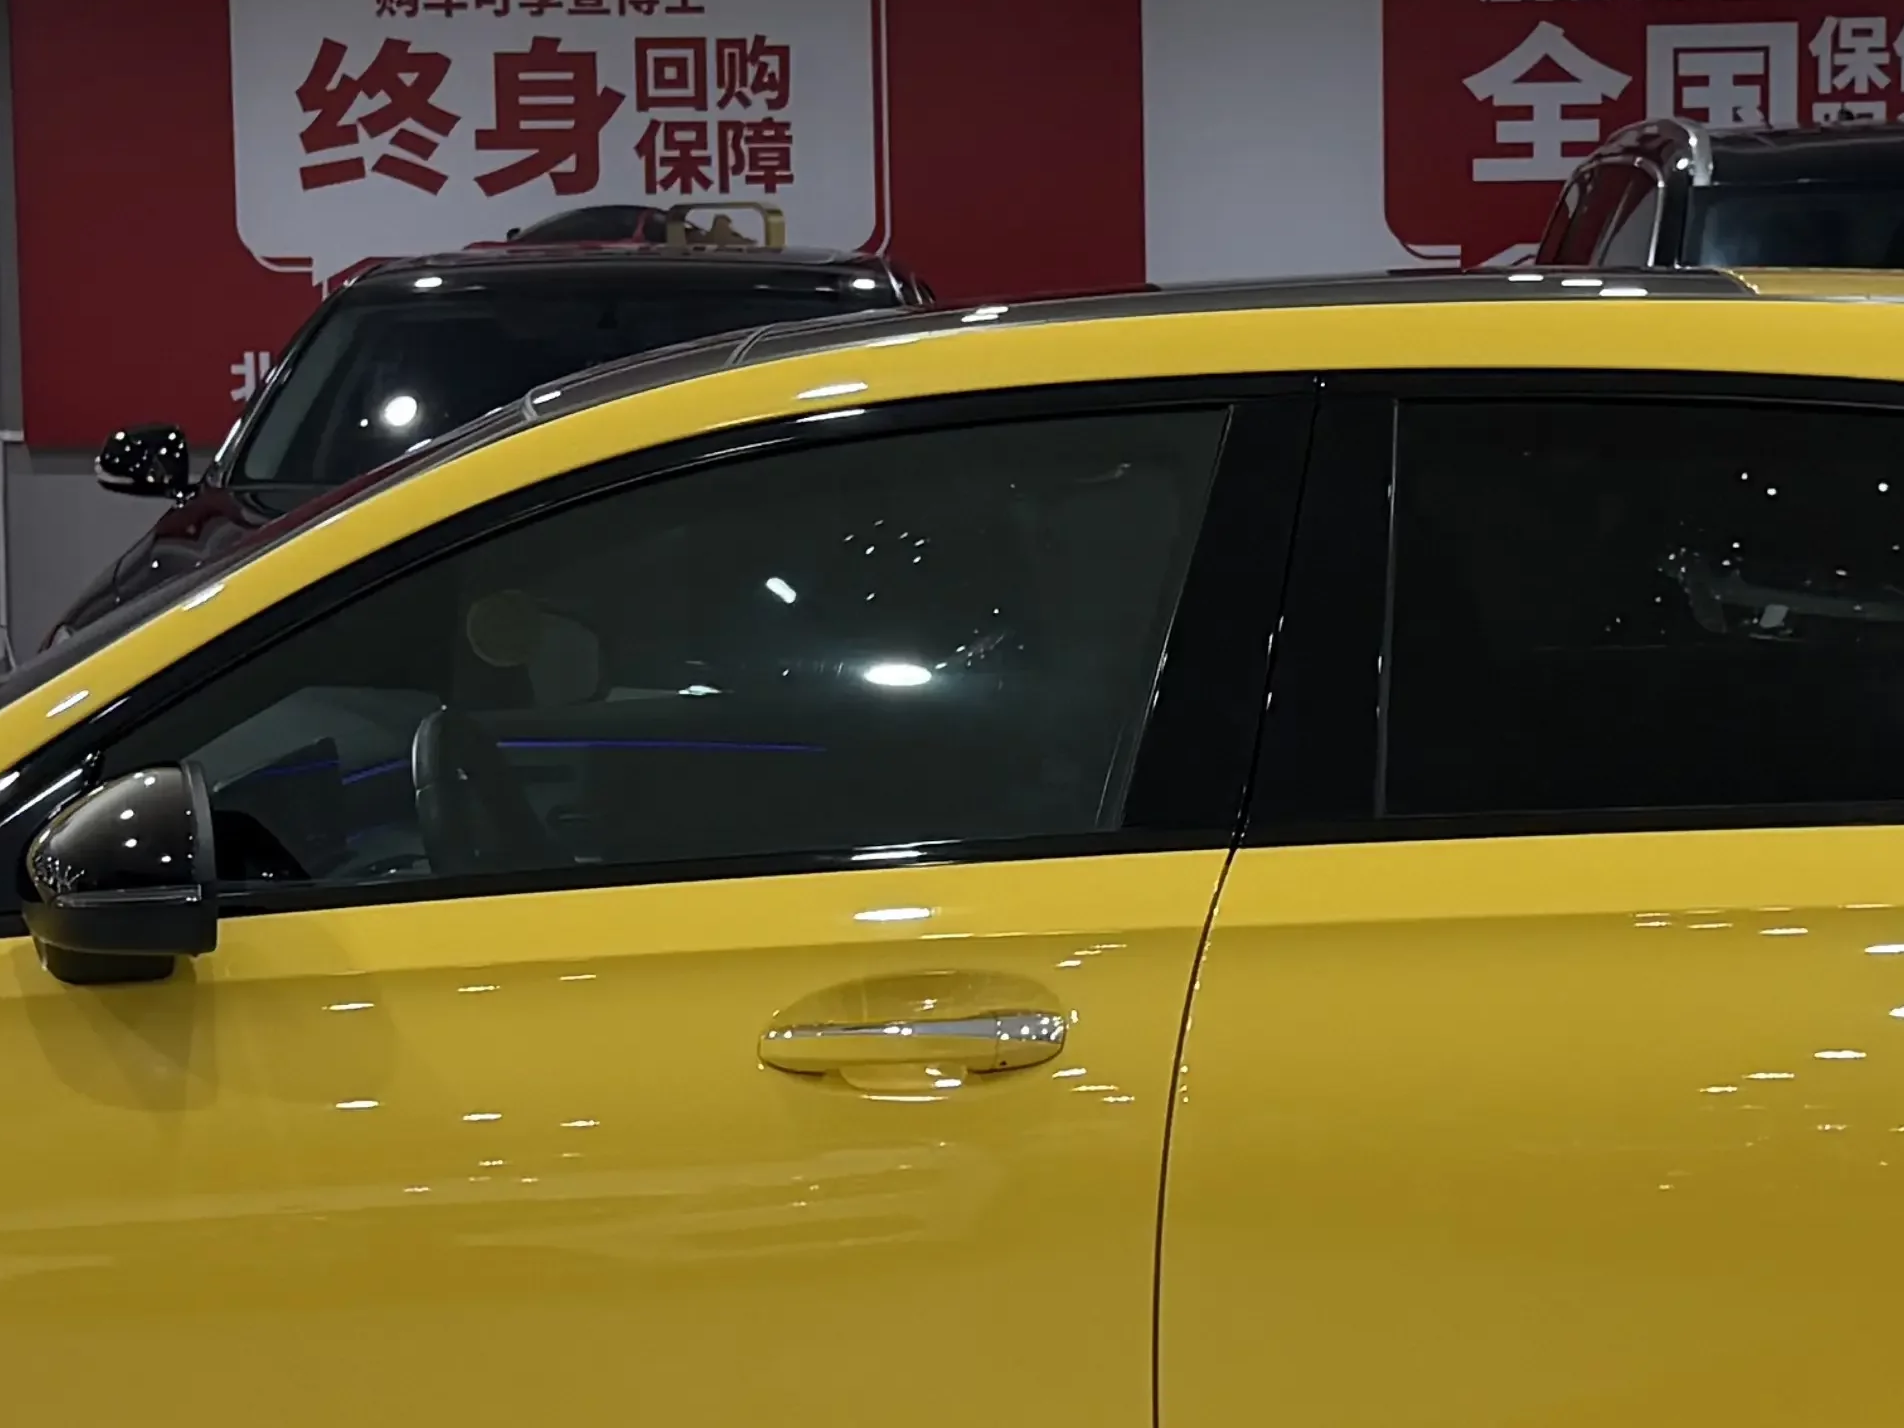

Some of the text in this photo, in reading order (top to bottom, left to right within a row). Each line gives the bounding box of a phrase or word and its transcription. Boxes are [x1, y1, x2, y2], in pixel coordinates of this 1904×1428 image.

[294, 34, 627, 198] 终身
[634, 34, 791, 113] 回购
[1461, 20, 1799, 182] 全国
[633, 116, 795, 197] 保障
